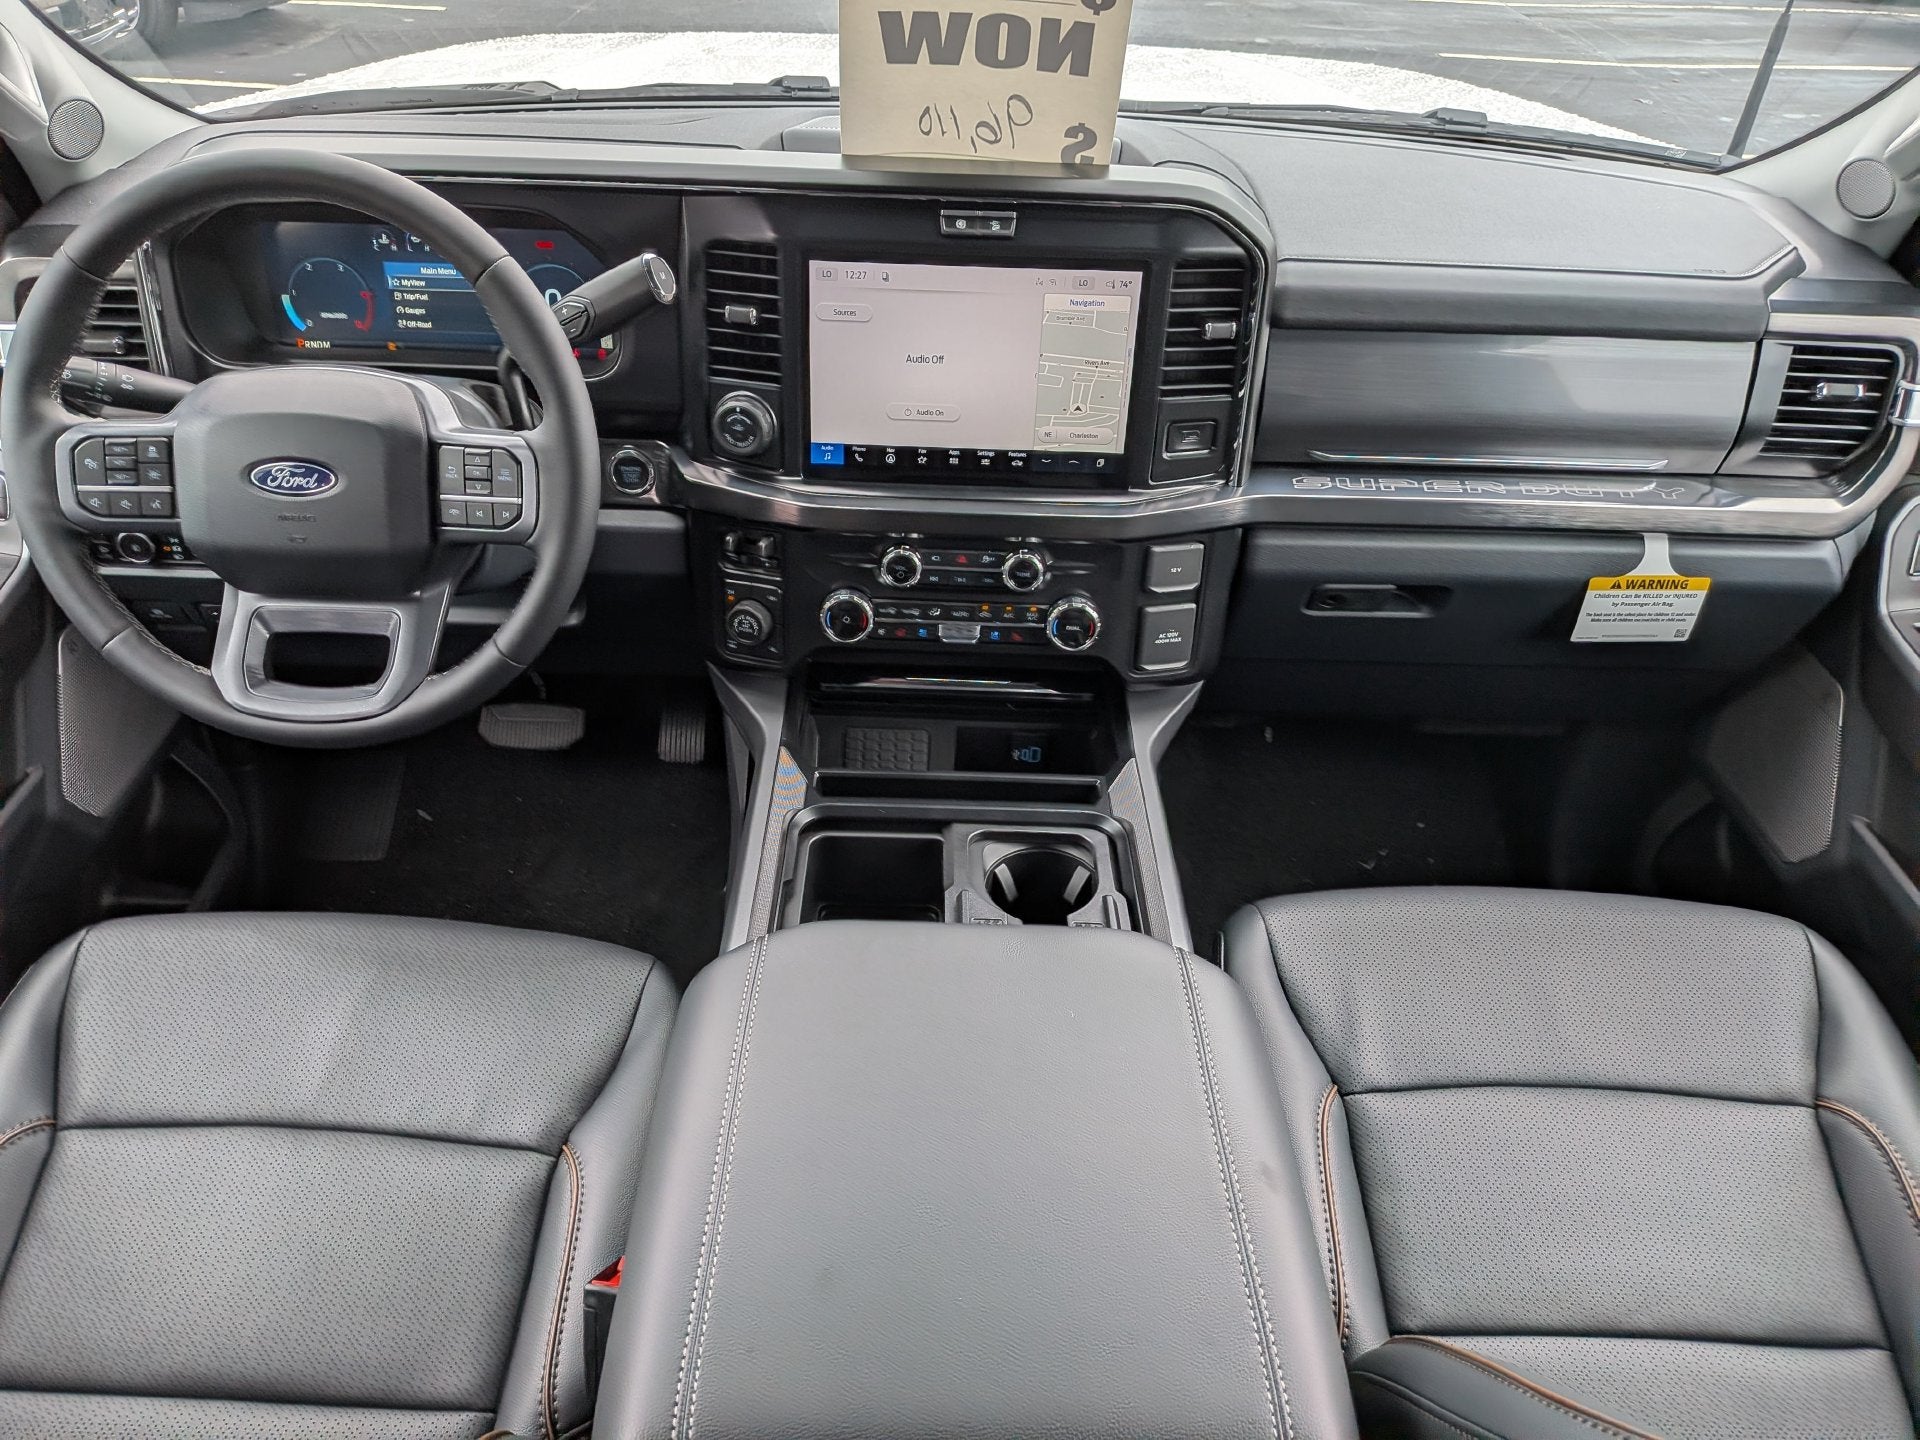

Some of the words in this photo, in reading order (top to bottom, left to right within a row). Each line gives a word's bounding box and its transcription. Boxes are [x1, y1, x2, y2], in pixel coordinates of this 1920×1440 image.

[420, 267, 437, 275] Main
[437, 267, 457, 275] Menu
[822, 270, 832, 278] LO
[845, 270, 867, 280] 12:27
[401, 279, 426, 287] MyView
[1078, 279, 1088, 287] LO
[403, 293, 429, 301] Trip/Fuel
[1069, 299, 1105, 308] Navigation
[405, 307, 426, 315] Gauges
[833, 308, 857, 317] Sources
[407, 320, 432, 329] Off-Road
[905, 354, 930, 364] Audio
[931, 354, 945, 365] Off
[915, 408, 934, 416] Audio
[1069, 432, 1099, 440] Charleston
[266, 465, 318, 489] Ford
[1291, 475, 1507, 495] SUPER
[1519, 481, 1686, 500] DUTY
[1625, 579, 1690, 590] WARNING
